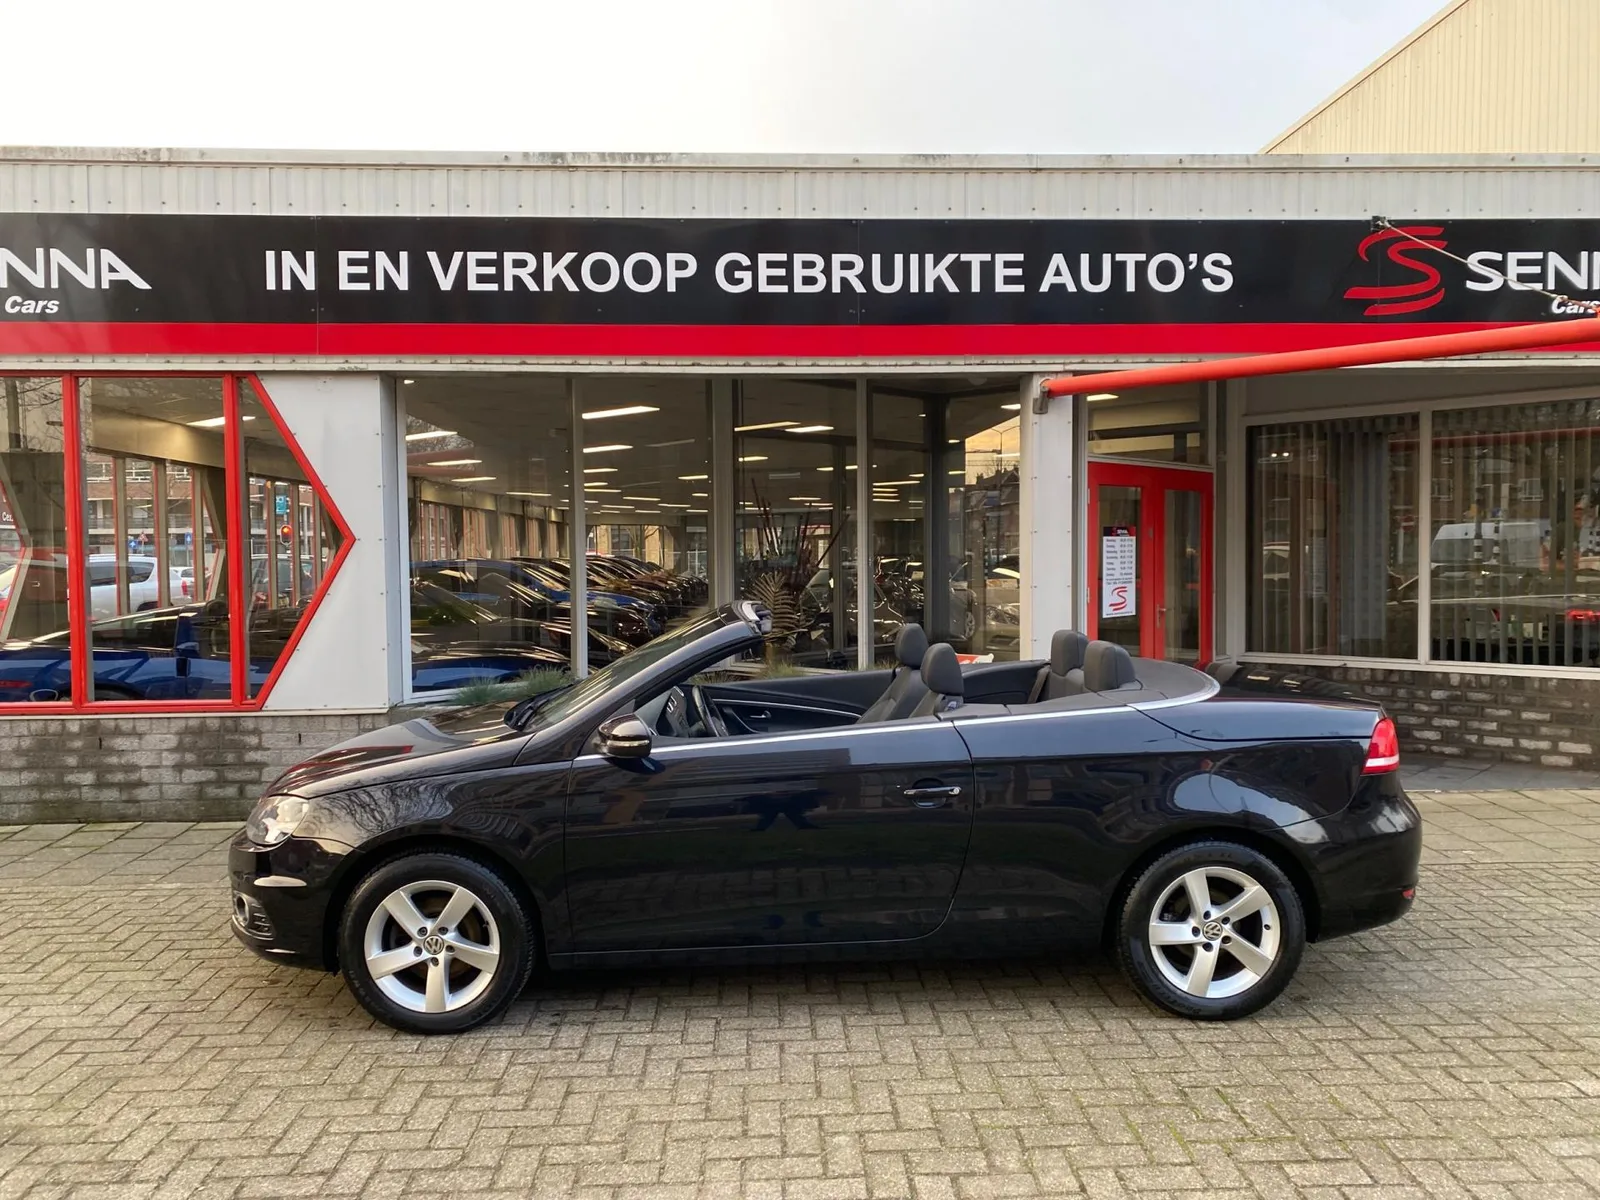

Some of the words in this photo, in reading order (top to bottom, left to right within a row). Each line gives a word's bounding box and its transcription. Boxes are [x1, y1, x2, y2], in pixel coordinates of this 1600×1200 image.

[265, 250, 316, 291] IN
[338, 250, 409, 291] EN
[427, 251, 698, 293] VERKOOP
[714, 252, 1025, 294] GEBRUIKTE
[1038, 252, 1234, 293] AUTO'S
[1465, 250, 1600, 291] SEN
[4, 295, 60, 314] Cars
